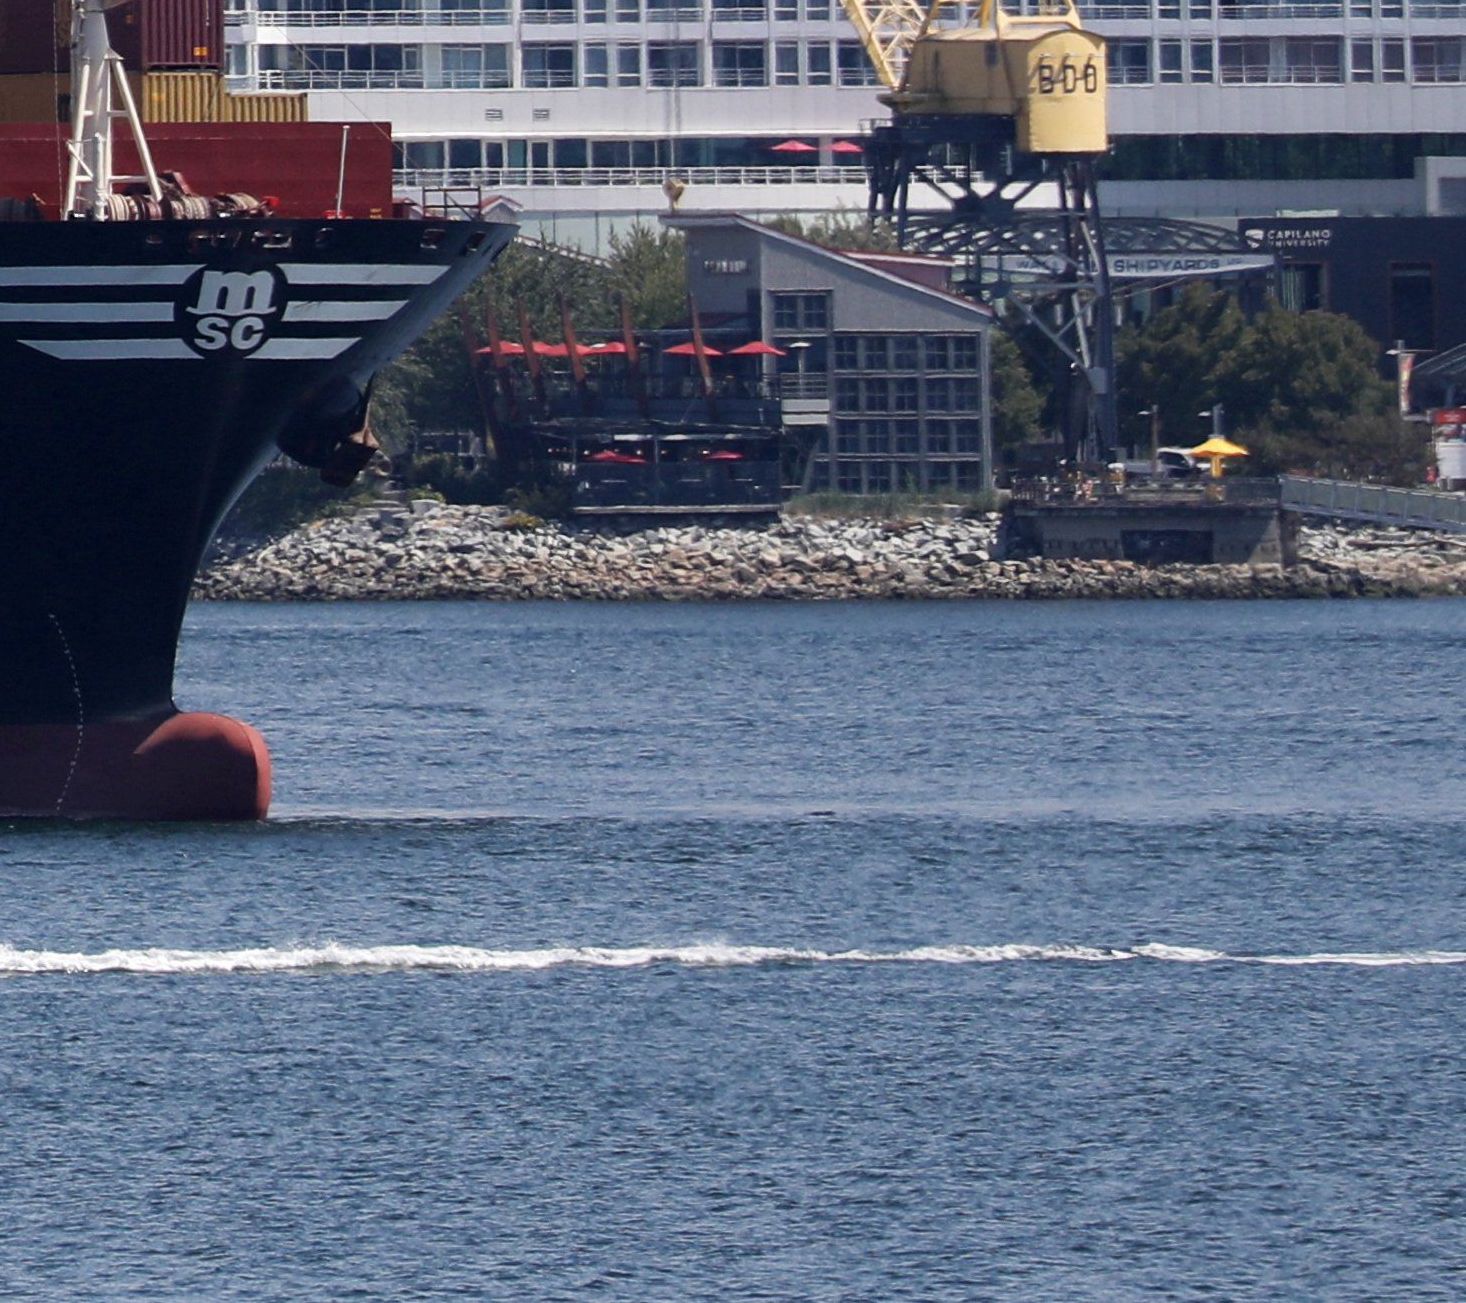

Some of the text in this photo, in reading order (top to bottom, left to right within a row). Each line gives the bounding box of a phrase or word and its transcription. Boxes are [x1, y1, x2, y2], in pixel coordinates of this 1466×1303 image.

[1267, 229, 1331, 239] CAPILANO
[1268, 239, 1330, 247] UNIVERSITY
[1113, 258, 1220, 273] SHIPYARDS
